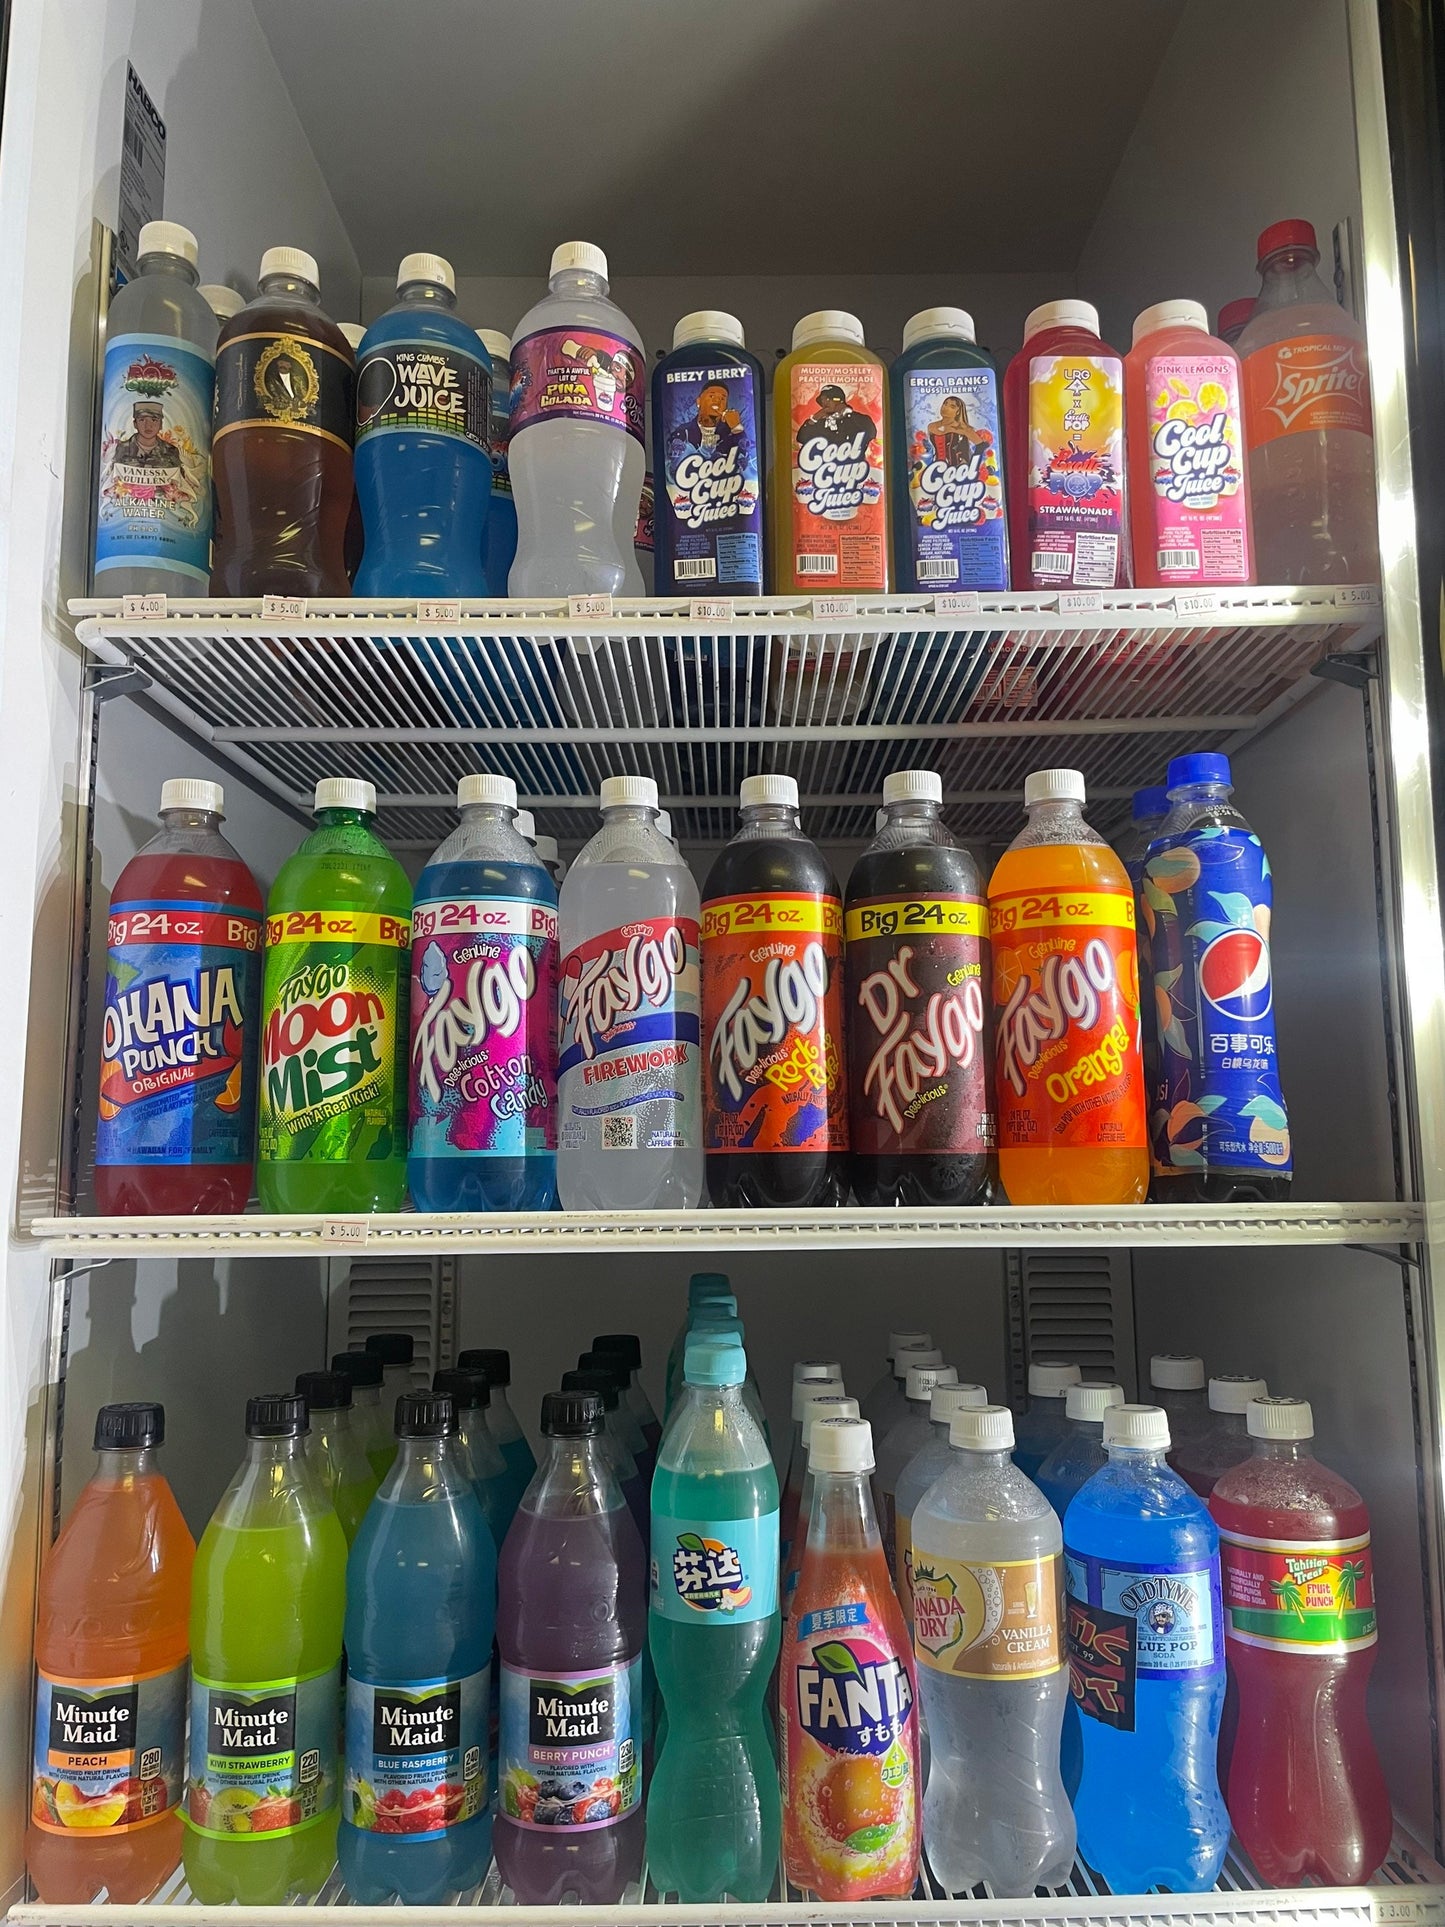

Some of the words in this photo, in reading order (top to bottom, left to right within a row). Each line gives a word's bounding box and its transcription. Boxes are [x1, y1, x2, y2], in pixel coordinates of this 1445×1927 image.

[128, 67, 165, 140] HABCO
[396, 354, 414, 362] KING
[1293, 344, 1330, 354] TROPICAL
[397, 363, 460, 388] WAVE
[548, 368, 565, 376] THAT'S
[571, 367, 590, 376] AWFUL
[666, 371, 704, 384] BEEZY
[708, 367, 747, 380] BERRY
[1063, 369, 1091, 380] LRG
[1157, 366, 1181, 374] PINK
[1185, 365, 1228, 374] LEMONS
[910, 377, 944, 387] ERICA
[949, 376, 989, 386] BANKS
[1276, 366, 1359, 406] Sprite
[395, 385, 466, 414] JUICE
[540, 395, 592, 408] COLADA
[1064, 421, 1089, 431] POP
[1155, 414, 1226, 457] Cool
[799, 432, 865, 471] Cool
[1173, 444, 1230, 474] Cup
[124, 467, 168, 476] VANESSA
[676, 446, 739, 491] Cool
[815, 461, 868, 489] Cup
[921, 455, 980, 494] Cool
[691, 475, 743, 505] Cup
[936, 480, 984, 507] Cup
[1167, 474, 1223, 502] Juice
[115, 498, 176, 510] ALKALINE
[808, 488, 861, 514] Juice
[1040, 506, 1113, 516] STRAWMONADE
[123, 508, 165, 519] WATER
[687, 503, 736, 529] Juice
[932, 506, 979, 532] Juice
[140, 602, 159, 612] 4.00
[586, 601, 605, 613] 5.00
[1184, 598, 1213, 609] $10.00
[1352, 591, 1370, 601] 5.00
[280, 603, 299, 614] 5.00
[436, 608, 454, 618] 5.00
[697, 606, 726, 617] $10.00
[820, 603, 849, 613] $10.00
[286, 912, 325, 935] 24
[413, 910, 436, 935] Big
[440, 904, 481, 926] 24
[531, 909, 558, 939] Big
[704, 911, 730, 935] Big
[734, 903, 774, 926] 24
[861, 910, 898, 936] Big
[903, 903, 946, 926] 24
[991, 906, 1017, 931] Big
[1022, 897, 1062, 919] 24
[107, 921, 127, 946] Big
[132, 912, 171, 935] 24
[227, 920, 258, 950] Big
[379, 917, 411, 947] Big
[453, 944, 500, 965] Genuine
[750, 943, 796, 963] Genuine
[1028, 938, 1076, 959] Genuine
[946, 962, 981, 987] Genuine
[280, 964, 347, 1013] Faygo
[567, 927, 684, 1060] Faygo
[859, 945, 920, 1037] Dr
[103, 967, 244, 1060] OHANA
[413, 944, 535, 1103] Faygo
[710, 943, 828, 1101] Faygo
[996, 939, 1114, 1097] Faygo
[264, 991, 385, 1069] Moon
[123, 1031, 217, 1078] PUNCH
[1210, 1033, 1274, 1054] 百事可乐
[583, 1043, 689, 1086] FIREWORK
[764, 1037, 820, 1091] Rock
[864, 978, 984, 1134] Faygo
[1046, 1014, 1130, 1104] Orange!
[268, 1027, 382, 1119] Mist
[460, 1053, 532, 1102] Cotton
[807, 1045, 840, 1091] Rye!
[132, 1066, 194, 1094] ORIGINAL
[286, 1117, 312, 1136] With
[314, 1109, 324, 1123] A
[324, 1097, 350, 1117] Real
[351, 1082, 379, 1106] Kick!
[490, 1078, 548, 1120] Candy
[1062, 1111, 1073, 1124] POP
[1074, 1103, 1085, 1116] WITH
[1085, 1096, 1102, 1110] OTHER
[340, 1226, 360, 1237] 5.00
[674, 1549, 742, 1593] 芬达
[1286, 1558, 1328, 1573] Tahitian
[1253, 1573, 1264, 1581] AND
[1294, 1569, 1322, 1585] Treat
[1305, 1596, 1333, 1607] PUNCH
[811, 1607, 858, 1631] 夏季限定
[920, 1618, 947, 1636] DRY
[1001, 1624, 1052, 1640] VANILLA
[1007, 1637, 1050, 1653] CREAM
[1170, 1640, 1198, 1651] POP
[799, 1660, 913, 1728] FANTA
[56, 1702, 129, 1723] Minute
[214, 1707, 288, 1727] Minute
[381, 1706, 453, 1725] Minute
[537, 1697, 609, 1716] Minute
[63, 1723, 118, 1743] Maid
[222, 1727, 277, 1747] Maid
[390, 1724, 444, 1746] Maid
[545, 1716, 600, 1737] Maid
[857, 1715, 904, 1747] すもも
[68, 1757, 107, 1766] PEACH
[143, 1751, 159, 1766] 280
[210, 1760, 226, 1768] KIWI
[229, 1757, 290, 1769] STRAWBERRY
[302, 1752, 318, 1768] 220
[402, 1755, 454, 1768] RASPBERRY
[533, 1751, 568, 1761] BERRY
[572, 1746, 610, 1760] PUNCH
[266, 1775, 293, 1783] FLAVORS
[583, 1766, 607, 1775] FLAVORS
[1390, 1905, 1410, 1917] 3.00
